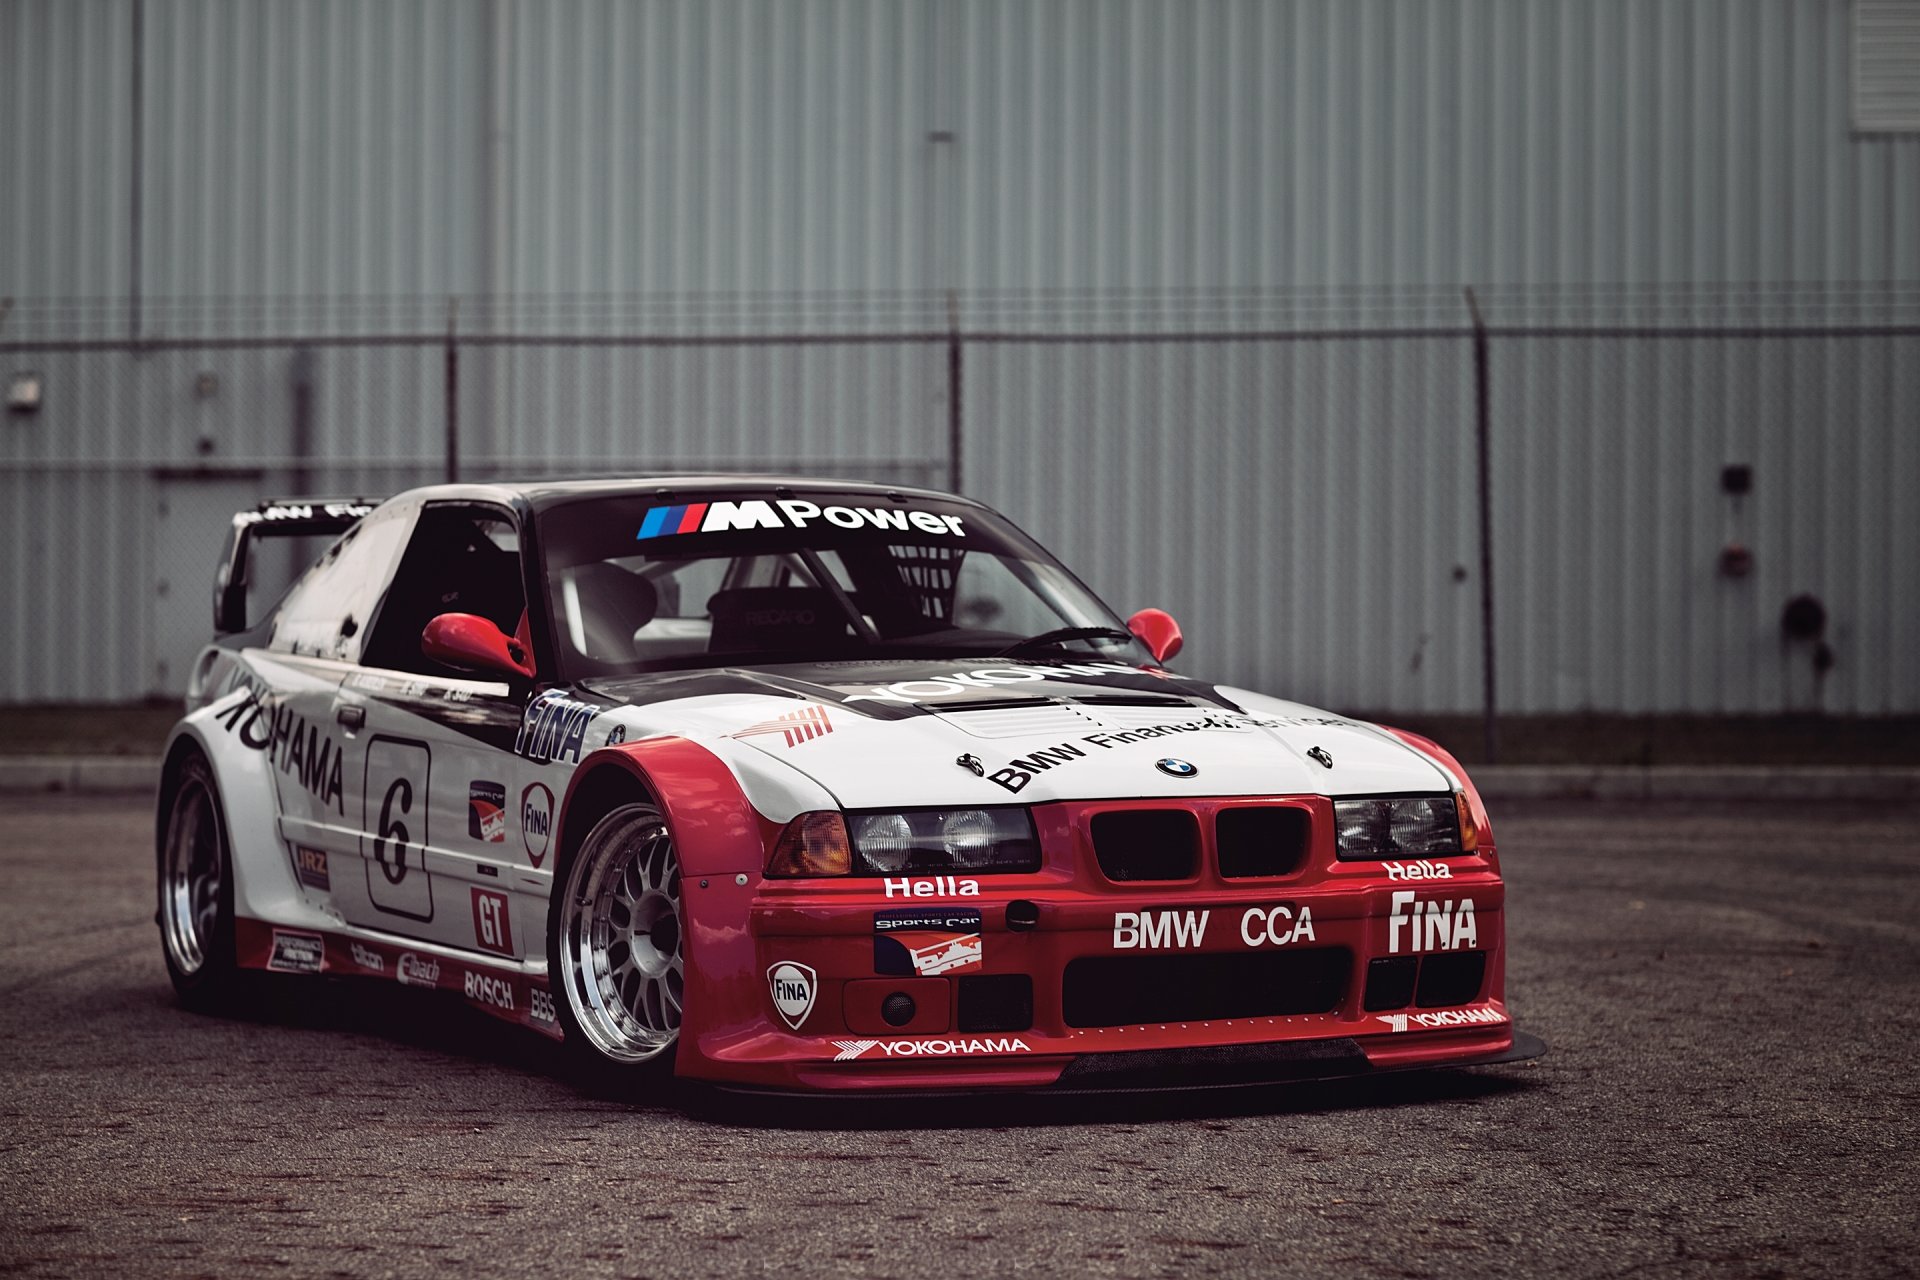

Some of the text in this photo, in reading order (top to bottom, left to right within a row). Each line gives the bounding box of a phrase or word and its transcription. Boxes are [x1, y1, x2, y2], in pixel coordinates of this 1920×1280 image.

[514, 688, 600, 767] FINA
[986, 743, 1087, 795] BMW
[374, 777, 413, 885] 6
[524, 803, 549, 837] FINA
[883, 876, 981, 898] Hella
[1381, 860, 1454, 881] Hella
[478, 894, 504, 948] GT
[875, 917, 980, 929] Sports Car
[1113, 906, 1317, 949] BMW CCA
[1388, 890, 1478, 953] FINA
[464, 970, 515, 1010] BOSCH
[530, 988, 556, 1022] BBS
[775, 979, 808, 1001] FINA
[1408, 1007, 1507, 1027] YOKOHAMA
[878, 1038, 1032, 1056] YOKOHAMA
